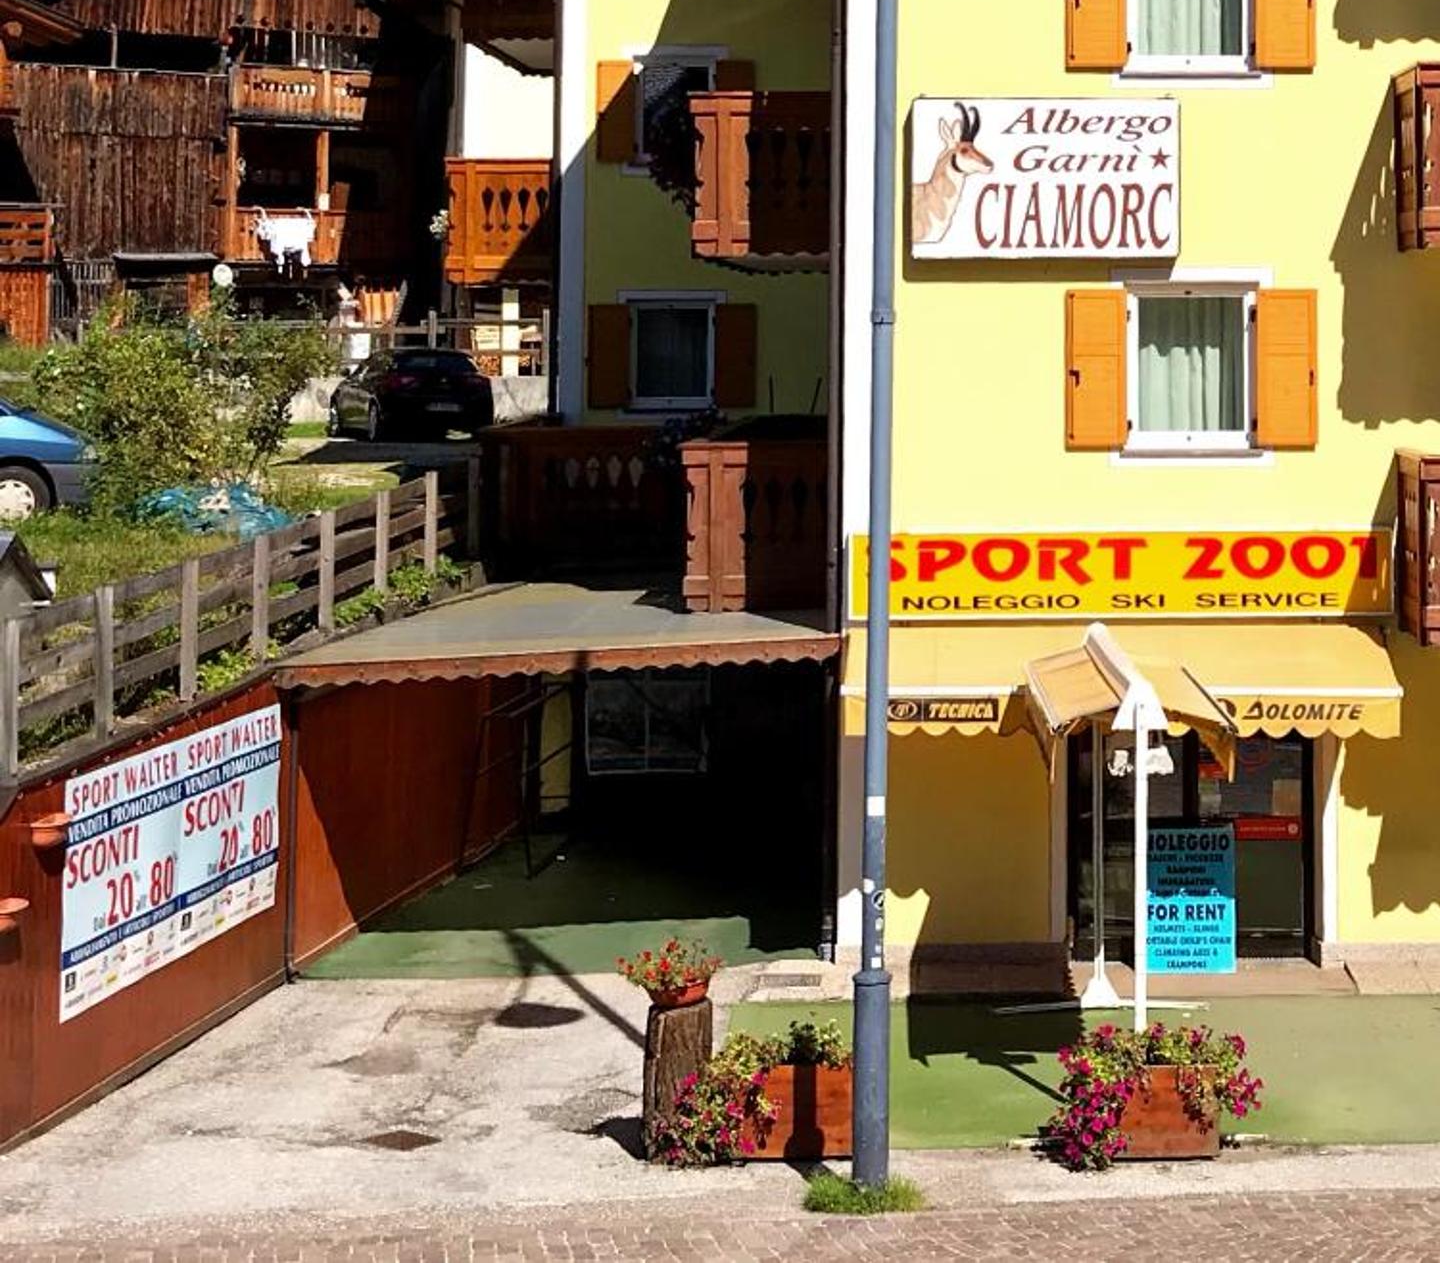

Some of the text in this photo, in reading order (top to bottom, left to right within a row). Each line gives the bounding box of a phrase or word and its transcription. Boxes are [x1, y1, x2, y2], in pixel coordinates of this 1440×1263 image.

[1001, 106, 1173, 142] Albergo
[1013, 144, 1142, 173] Garnì
[974, 181, 1174, 249] CIAMORC
[1182, 535, 1378, 580] 2001
[902, 592, 1339, 611] NOLEGGIO SKI SERVICE
[928, 703, 994, 719] TECNICA
[1242, 700, 1366, 721] DOLOMITE
[188, 714, 277, 770] SPORT WALTER
[72, 751, 178, 816] SPORT WALTER
[184, 779, 245, 837] SCONTI
[66, 824, 139, 889] SCONTI
[1148, 904, 1226, 921] FOR RENT
